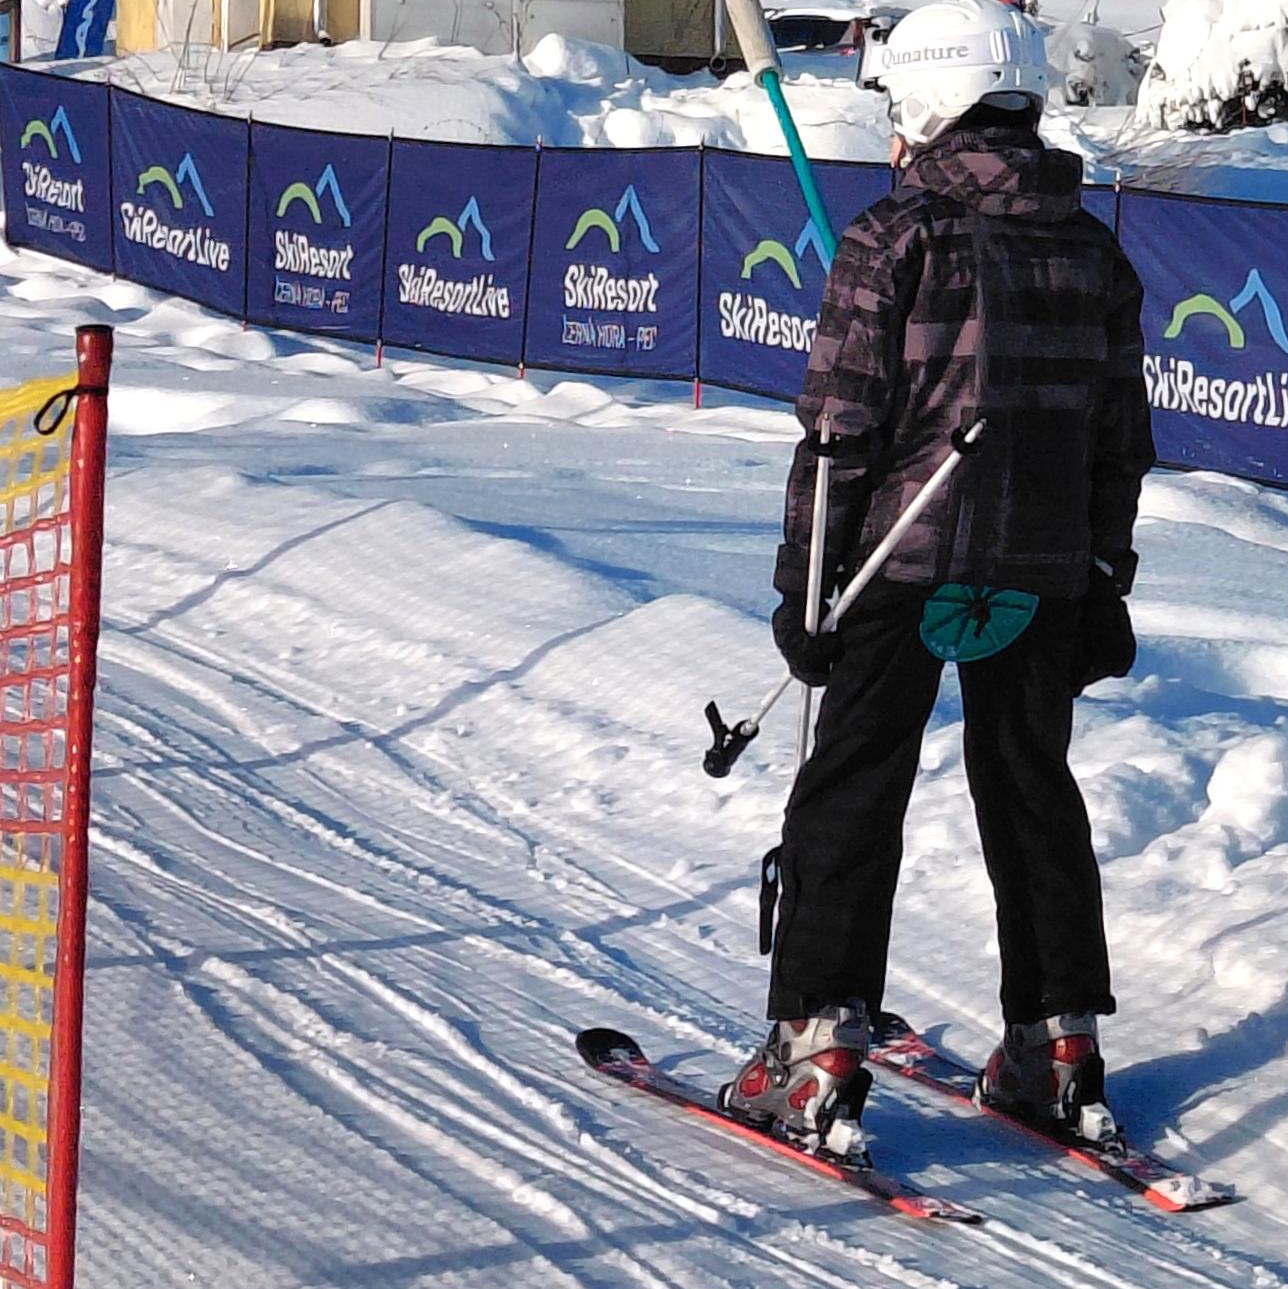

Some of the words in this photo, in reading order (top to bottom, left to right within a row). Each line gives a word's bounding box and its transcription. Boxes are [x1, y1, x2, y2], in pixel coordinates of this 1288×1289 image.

[275, 230, 354, 281] SkiResort
[398, 264, 510, 319] SkiResortLive
[564, 264, 659, 312] SkiResort
[719, 292, 820, 353] SkiResor
